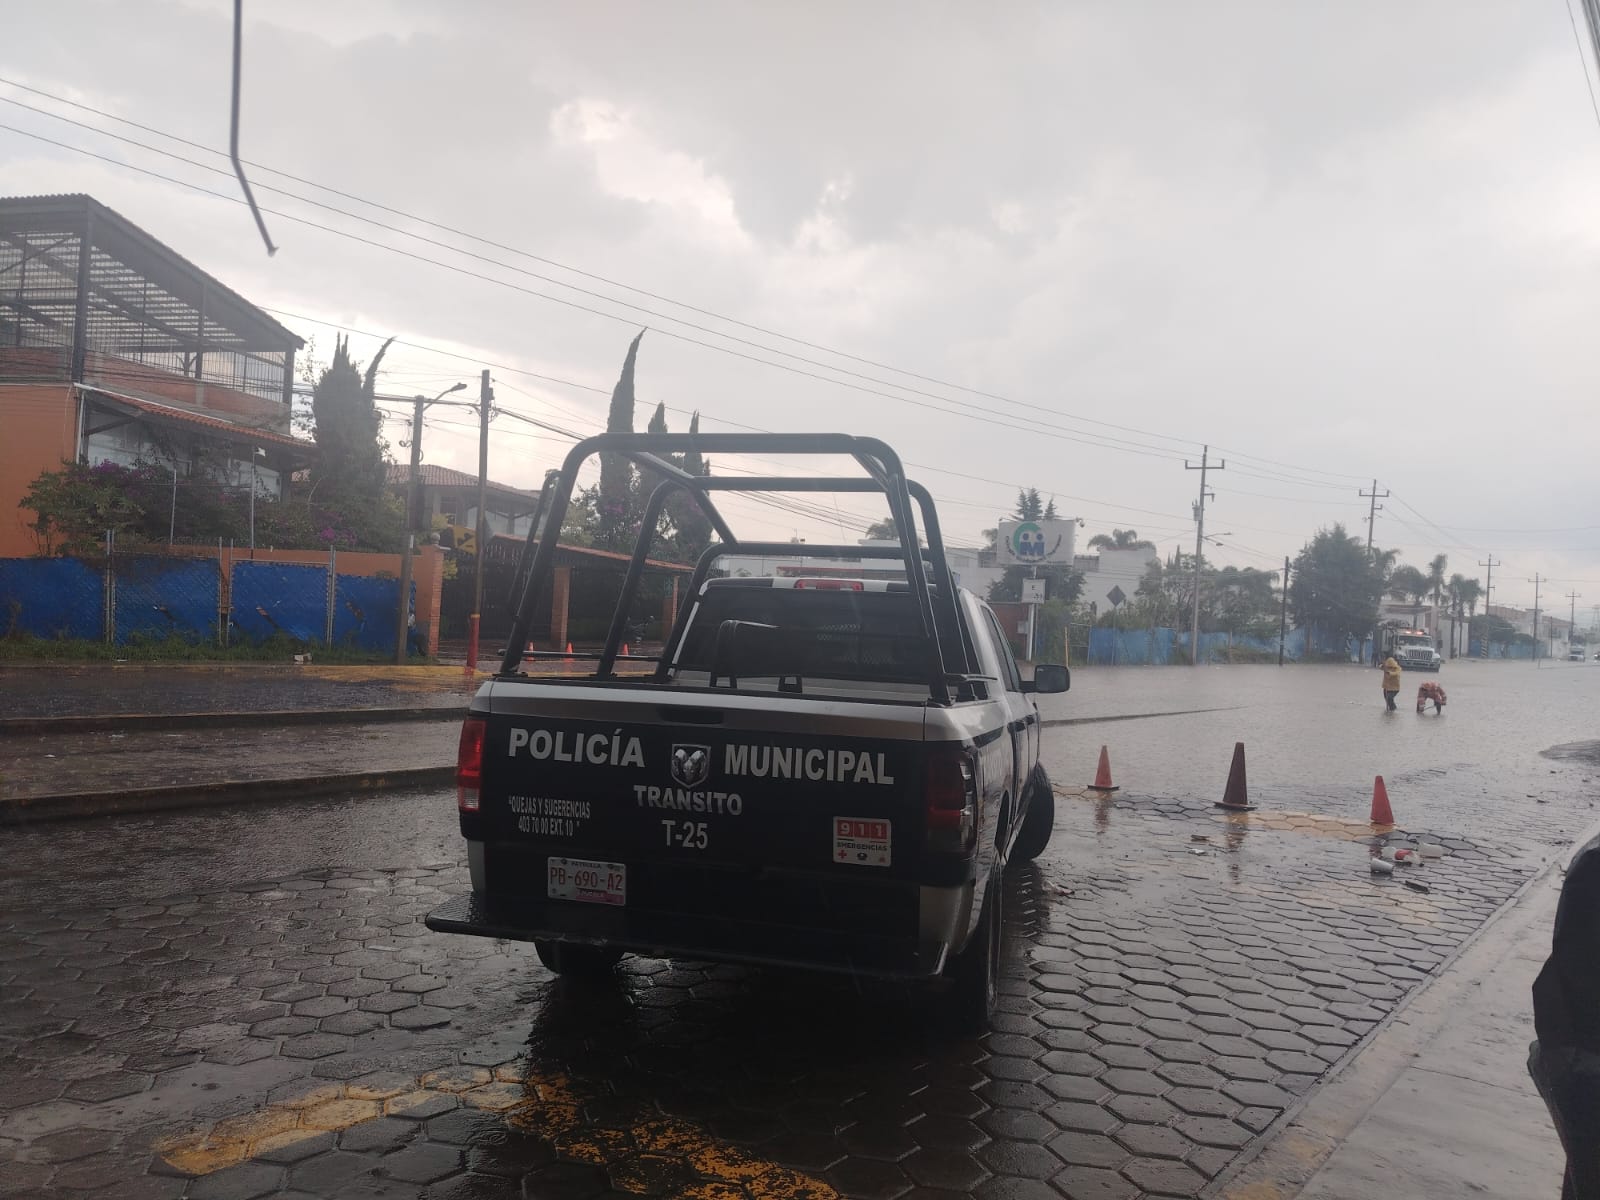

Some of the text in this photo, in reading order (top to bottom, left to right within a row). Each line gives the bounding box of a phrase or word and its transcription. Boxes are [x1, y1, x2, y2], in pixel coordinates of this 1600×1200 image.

[507, 727, 895, 785] POLICÍA MUNICIPAL
[537, 796, 543, 815] Y
[544, 797, 592, 819] SUGERENCIAS
[633, 784, 743, 816] TRANSITO
[518, 815, 530, 833] 403
[531, 816, 540, 834] 70
[540, 817, 549, 835] 00
[661, 819, 709, 850] T-25
[839, 822, 883, 837] 911
[837, 841, 888, 851] EMERGENCIAS
[550, 866, 624, 891] PB-690-A2
